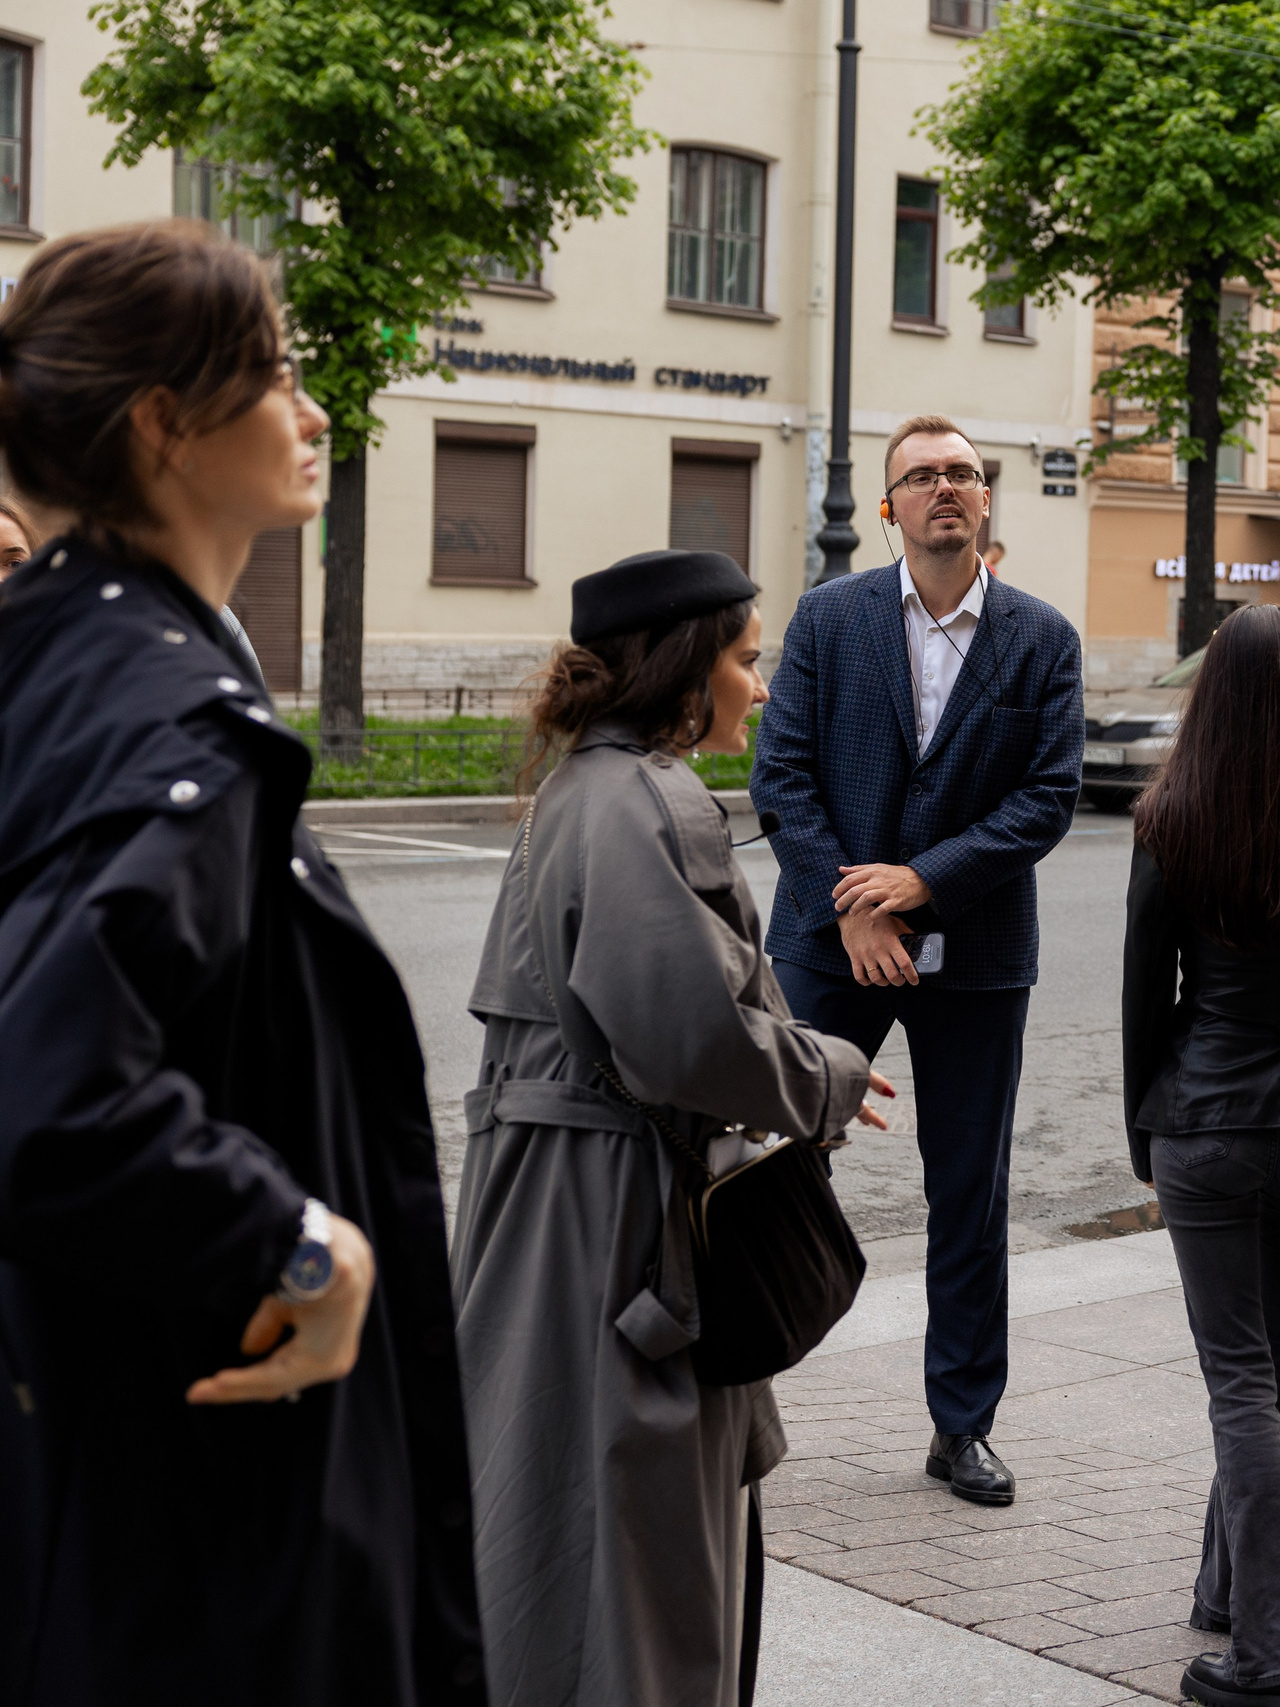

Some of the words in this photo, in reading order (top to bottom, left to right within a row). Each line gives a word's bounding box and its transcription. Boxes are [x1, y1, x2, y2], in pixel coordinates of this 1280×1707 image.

[434, 338, 635, 382] Национальный
[655, 366, 771, 399] стандарт
[1229, 560, 1280, 583] ДЕТЕЙ
[922, 943, 930, 964] 19:01
